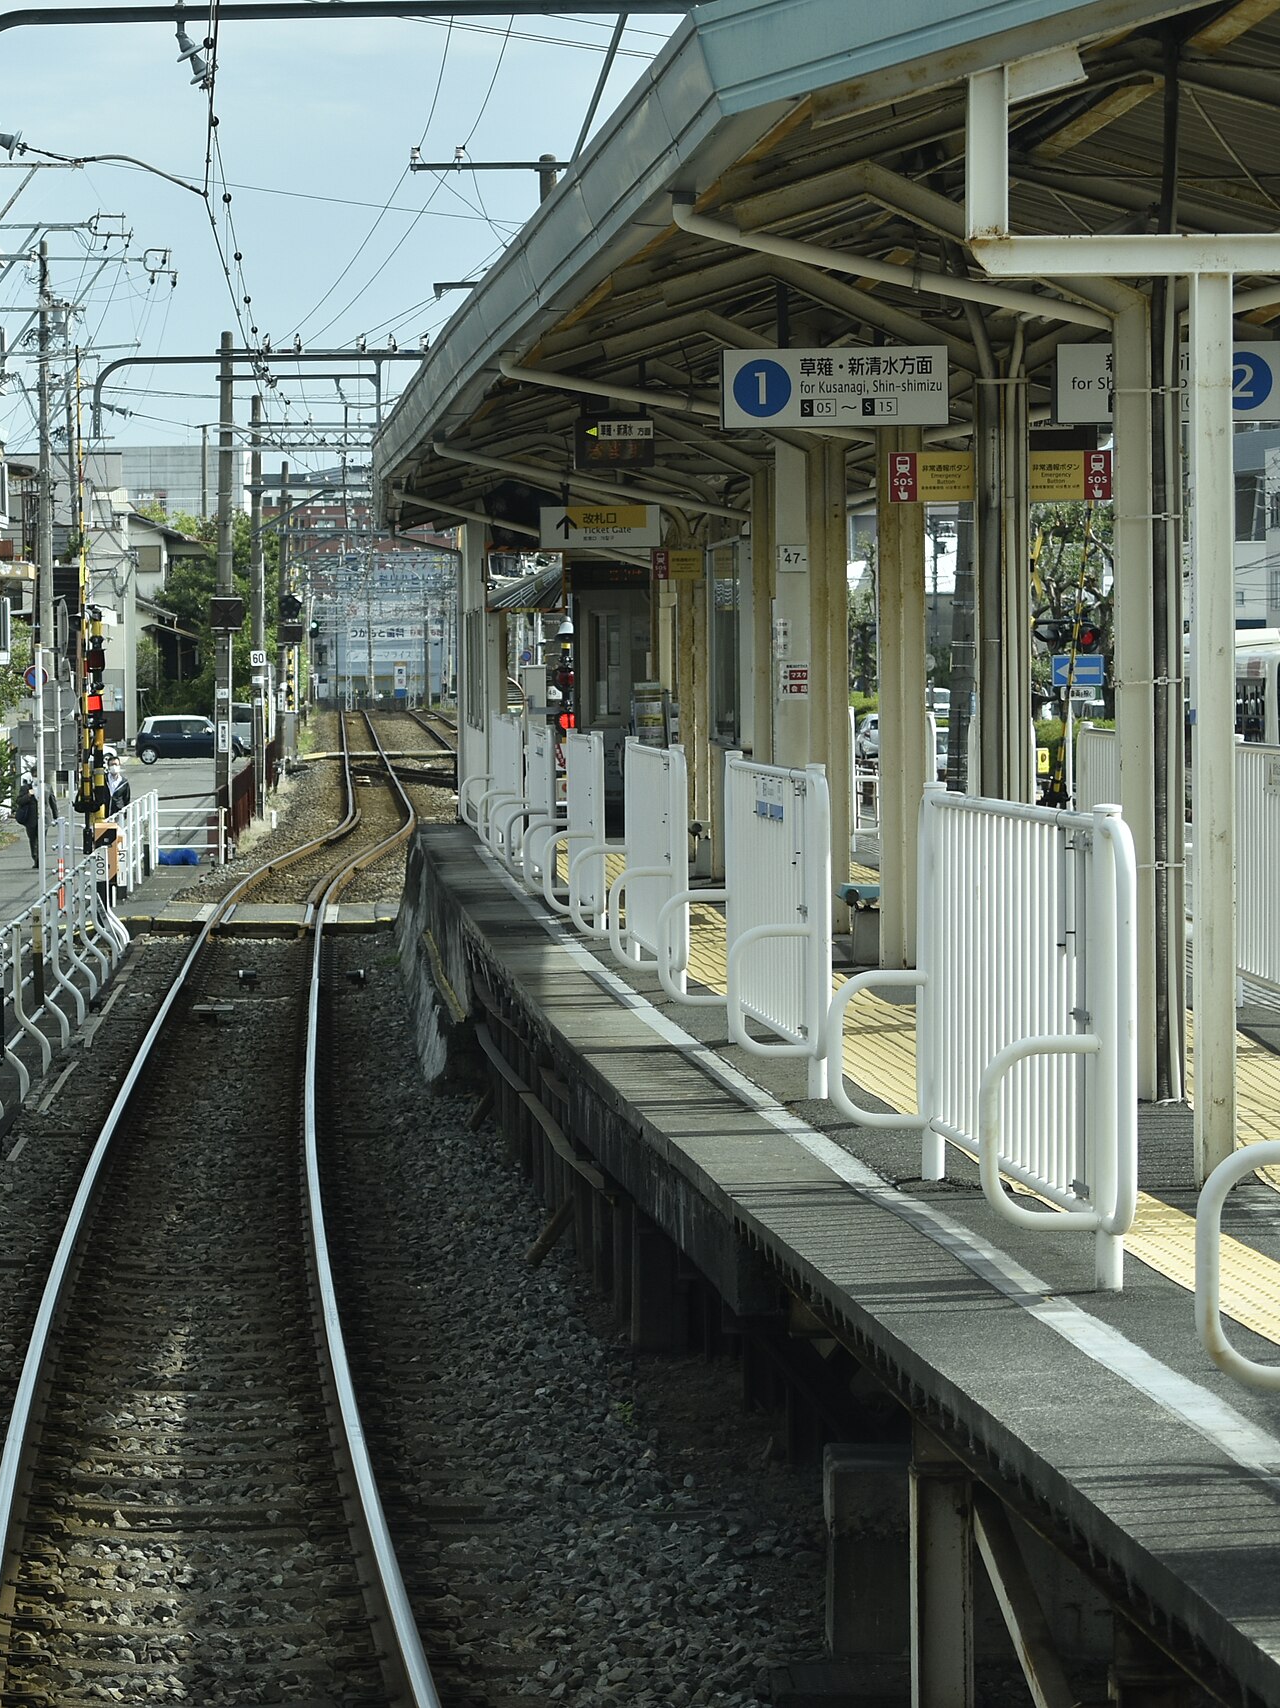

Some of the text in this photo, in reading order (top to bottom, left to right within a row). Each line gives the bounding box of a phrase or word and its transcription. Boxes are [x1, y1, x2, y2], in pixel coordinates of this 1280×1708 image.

[799, 355, 933, 377] 草薙・新清水方面
[1072, 377, 1093, 391] for
[1235, 364, 1254, 397] 2
[754, 371, 767, 405] 1
[800, 379, 943, 396] for Kusanagi, Shin-shimizu
[803, 403, 811, 414] S
[816, 402, 832, 414] 05
[864, 402, 872, 413] S
[879, 401, 893, 413] 15
[893, 477, 913, 486] SOS
[1087, 475, 1108, 484] SOS
[582, 512, 617, 524] 改札口
[583, 525, 632, 534] Ticket Gate
[252, 653, 264, 664] 60
